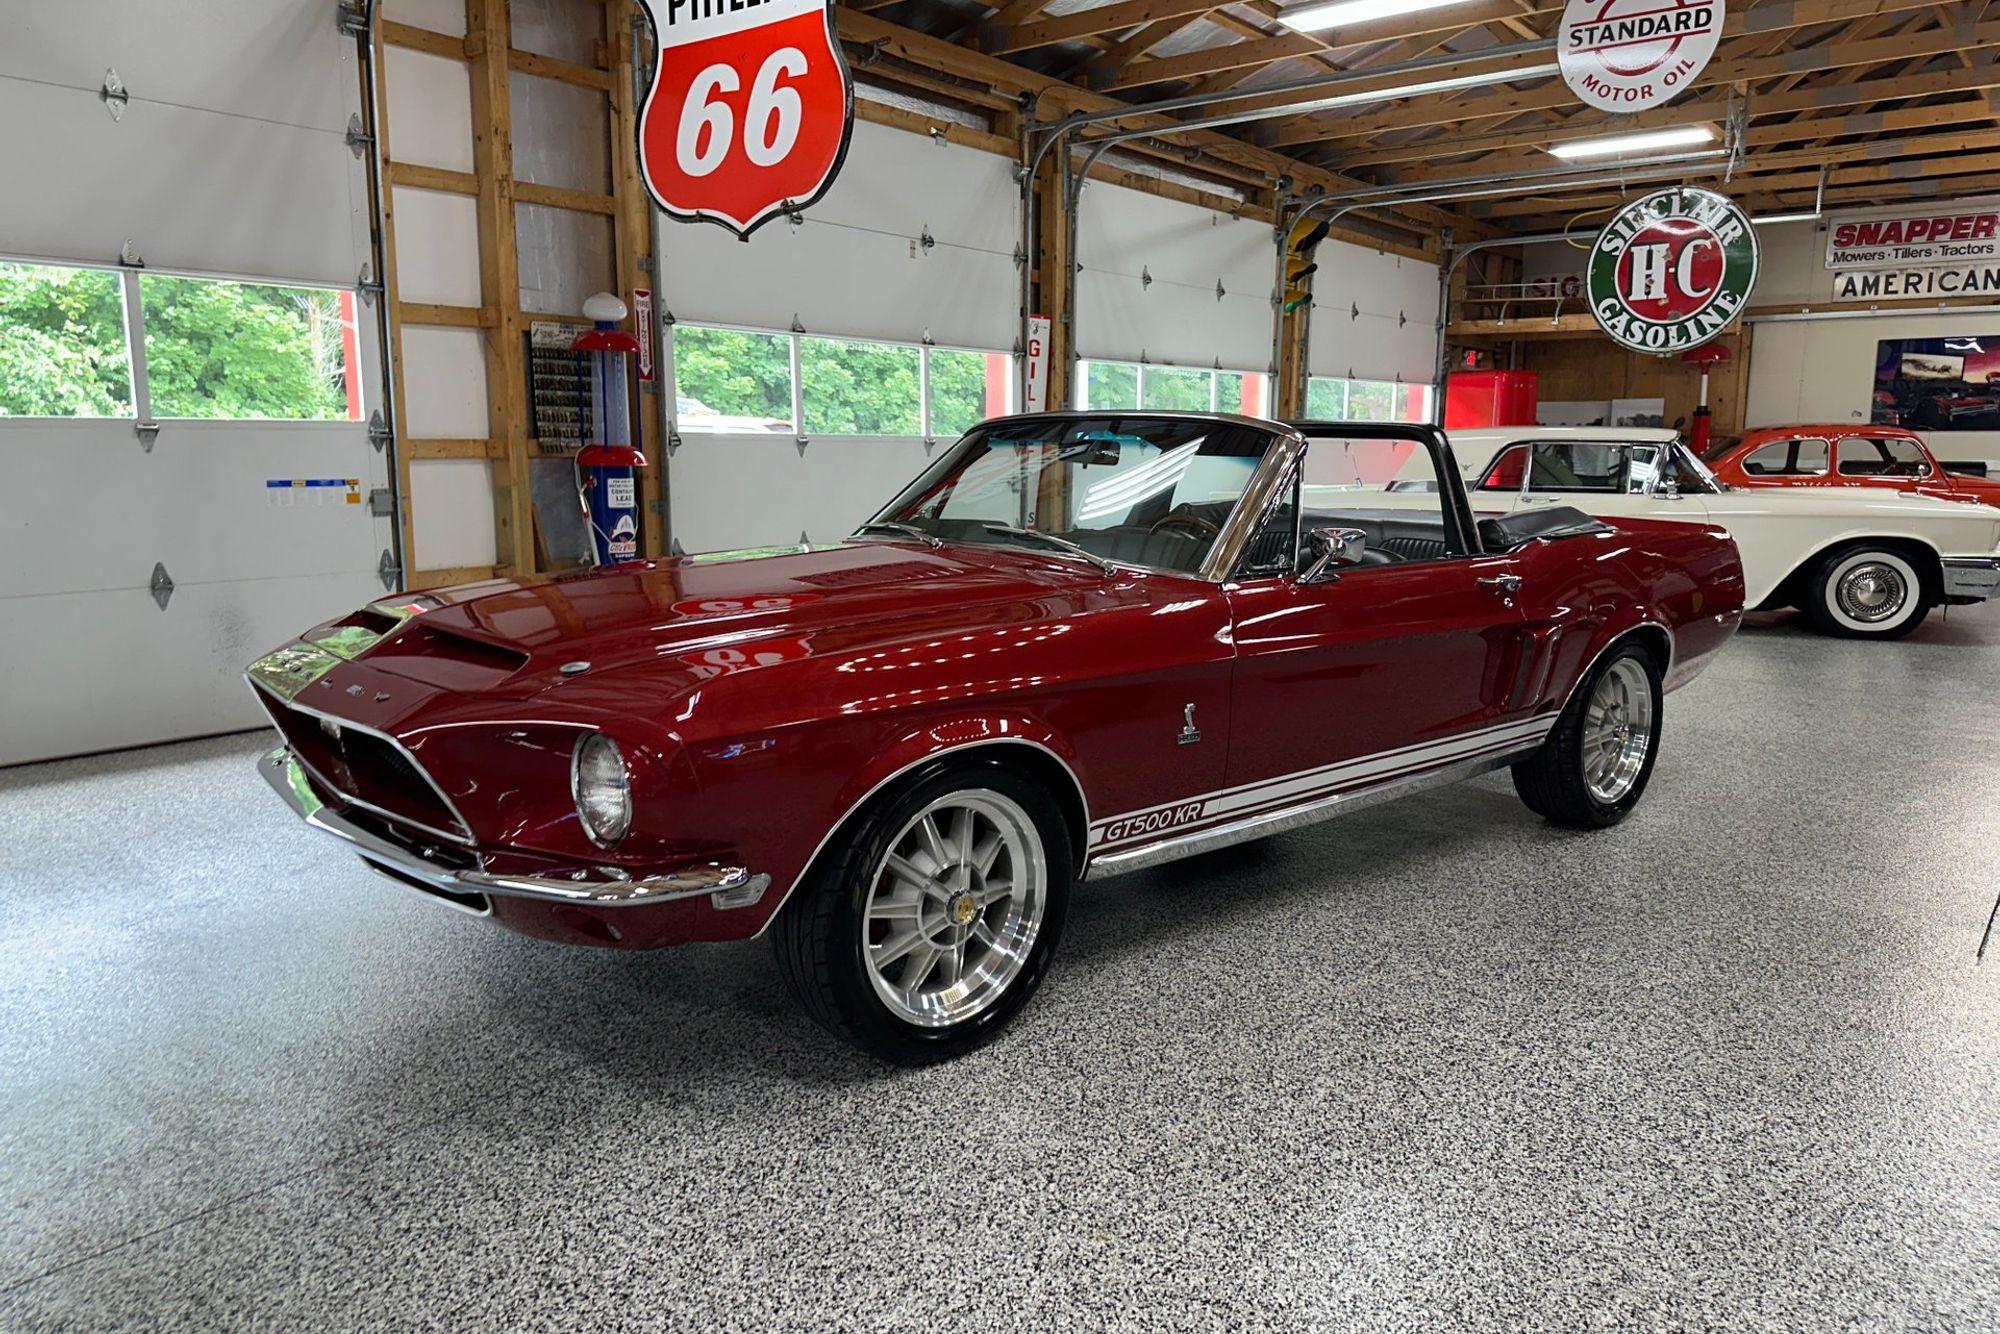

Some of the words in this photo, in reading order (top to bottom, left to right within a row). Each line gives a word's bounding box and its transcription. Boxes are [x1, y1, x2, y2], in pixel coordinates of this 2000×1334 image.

[1569, 8, 1712, 47] STANDARD
[1582, 74, 1653, 101] MOTOR
[1664, 59, 1695, 86] OIL
[676, 47, 808, 177] 66
[1601, 194, 1743, 255] SINCLAIR
[1833, 214, 1999, 248] SNAPPER
[1833, 250, 1885, 263] Mowers
[1893, 246, 1932, 259] Tillers
[1940, 242, 1994, 256] Tractors
[1841, 269, 2000, 297] AMERICAN
[1598, 290, 1741, 346] GASOLINE
[1107, 810, 1172, 840] GT500
[1173, 803, 1201, 825] KR
